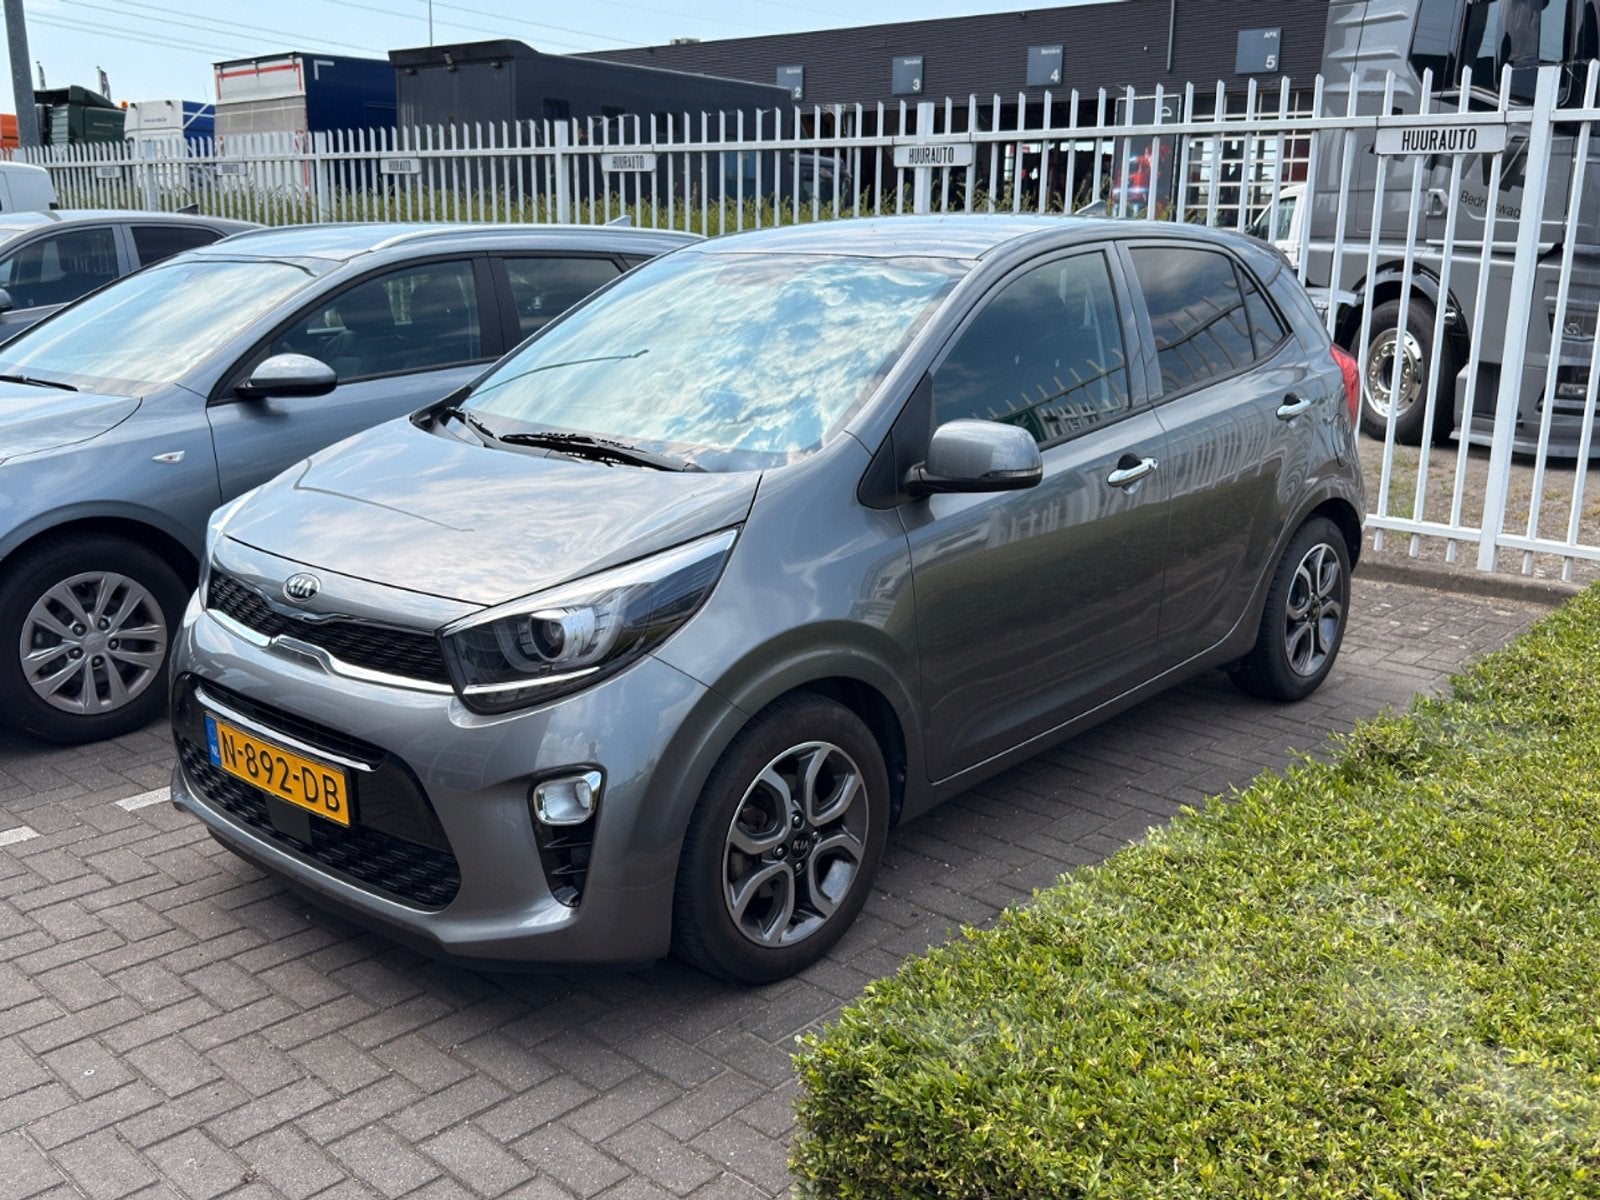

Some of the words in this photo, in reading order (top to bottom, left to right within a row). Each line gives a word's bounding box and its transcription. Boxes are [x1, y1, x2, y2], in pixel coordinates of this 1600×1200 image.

[1265, 55, 1276, 69] 5
[1050, 69, 1059, 82] 4
[912, 78, 920, 91] 3
[794, 86, 801, 98] 2
[1402, 128, 1477, 151] HUURAUTO
[908, 146, 954, 164] HUURAUTO
[289, 577, 313, 597] KIA
[221, 730, 340, 812] N-892-DB
[793, 839, 809, 850] KIA
